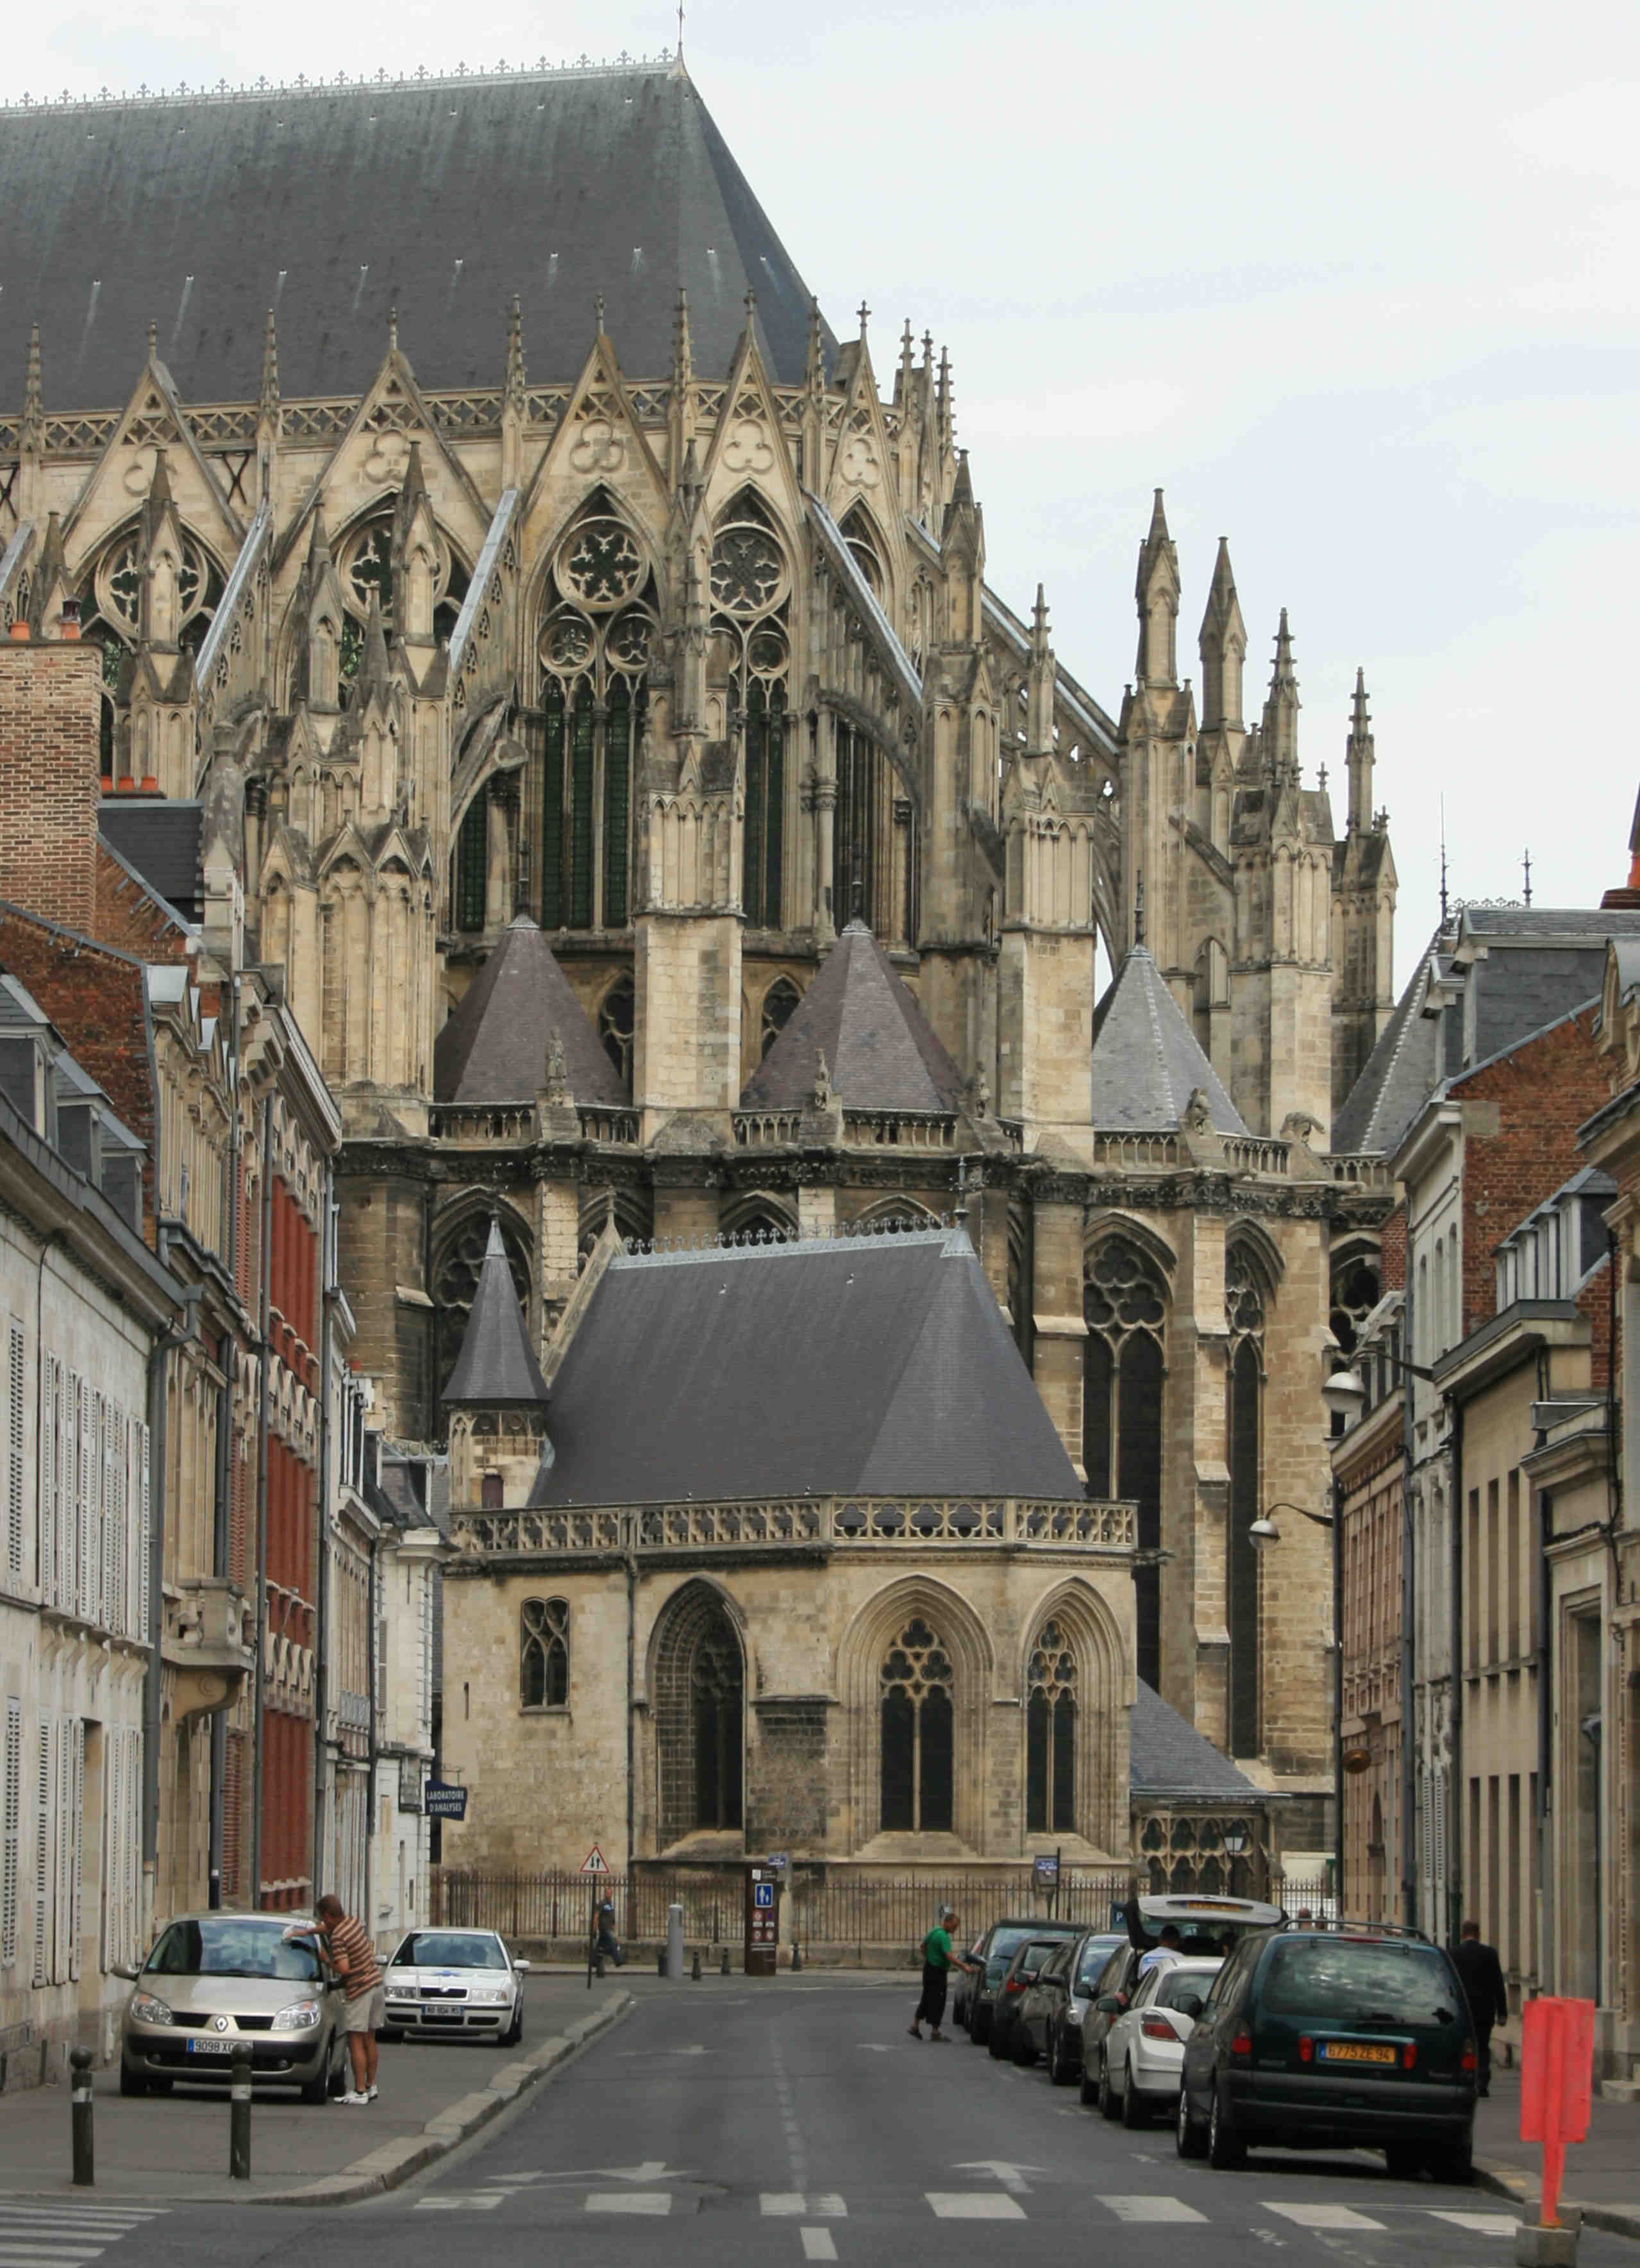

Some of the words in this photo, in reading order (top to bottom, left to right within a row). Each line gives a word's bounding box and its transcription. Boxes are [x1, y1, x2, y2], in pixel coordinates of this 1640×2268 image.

[426, 1790, 464, 1801] LABORATOIRE
[430, 1802, 462, 1812] D'ANALYSES
[1116, 1912, 1123, 1922] P
[195, 2041, 220, 2052] 9098
[1328, 2045, 1358, 2058] 6775
[1376, 2047, 1390, 2060] 94
